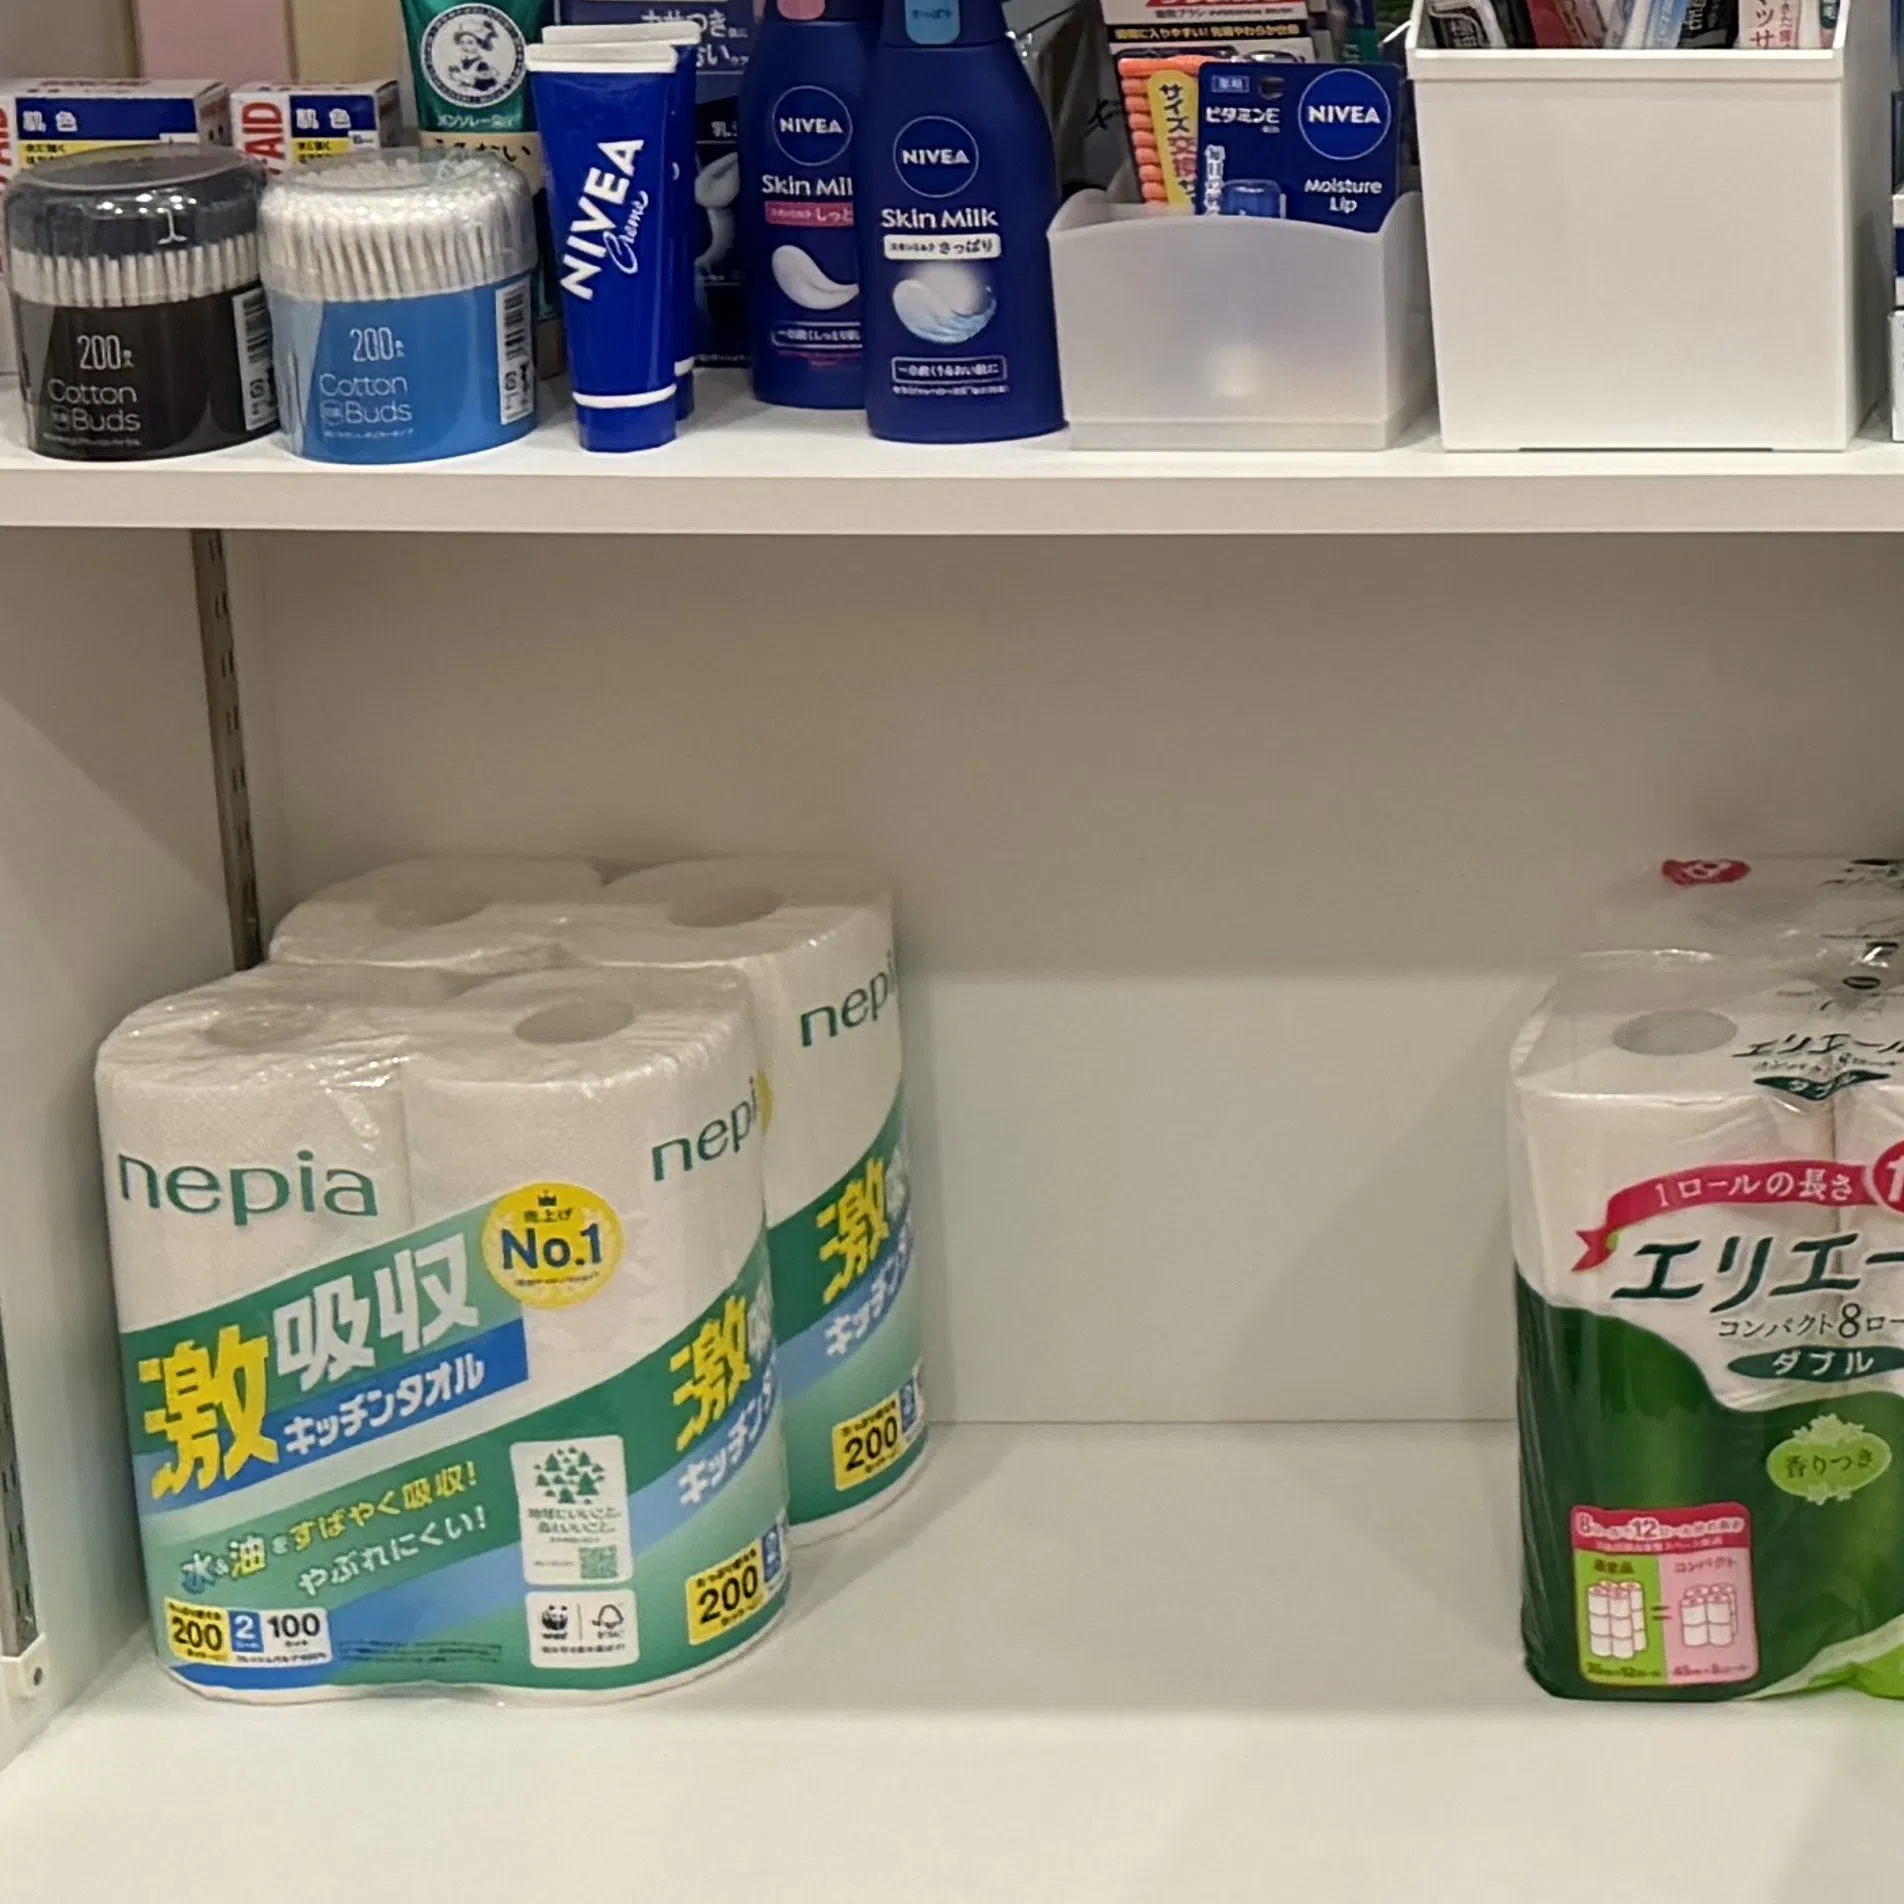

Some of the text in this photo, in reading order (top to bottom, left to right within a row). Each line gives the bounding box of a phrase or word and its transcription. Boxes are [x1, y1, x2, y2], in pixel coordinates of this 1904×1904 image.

[780, 116, 843, 134] NIVEA
[1307, 105, 1381, 125] NIVEA
[902, 148, 970, 165] NIVEA
[762, 175, 853, 195] Skin Mil
[559, 138, 645, 300] NIVEA
[881, 207, 999, 229] Skin Milk
[47, 379, 137, 404] Cotton
[319, 373, 408, 397] Cotton
[71, 406, 141, 432] Buds
[344, 399, 413, 425] Buds
[118, 1151, 379, 1225] nepia
[500, 1227, 603, 1271] No.1
[1771, 1347, 1873, 1376] ダブル
[266, 1612, 322, 1638] 100
